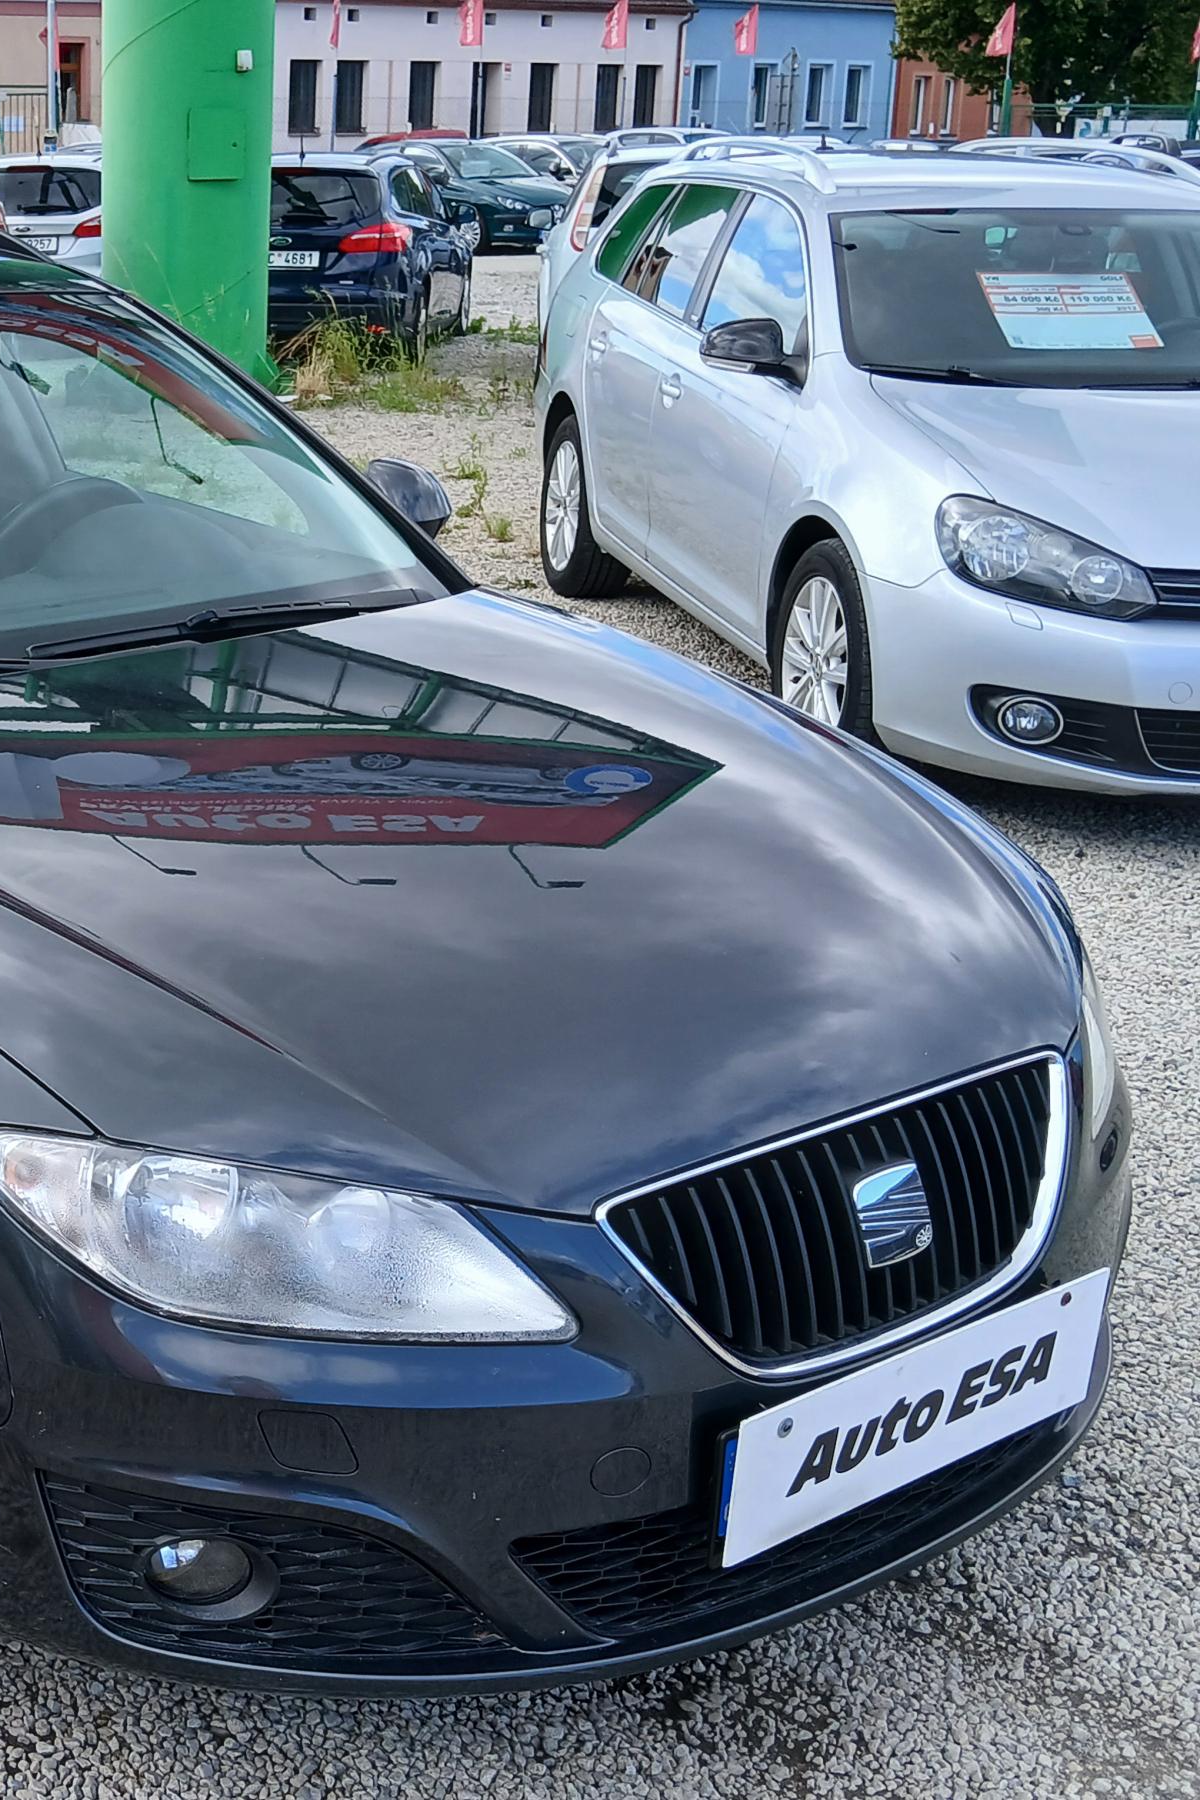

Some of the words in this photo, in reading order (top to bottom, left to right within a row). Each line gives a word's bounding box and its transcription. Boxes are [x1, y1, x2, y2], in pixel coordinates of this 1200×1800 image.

[284, 252, 313, 265] 4681
[785, 1388, 945, 1498] Auto
[945, 1330, 1058, 1425] ESA
